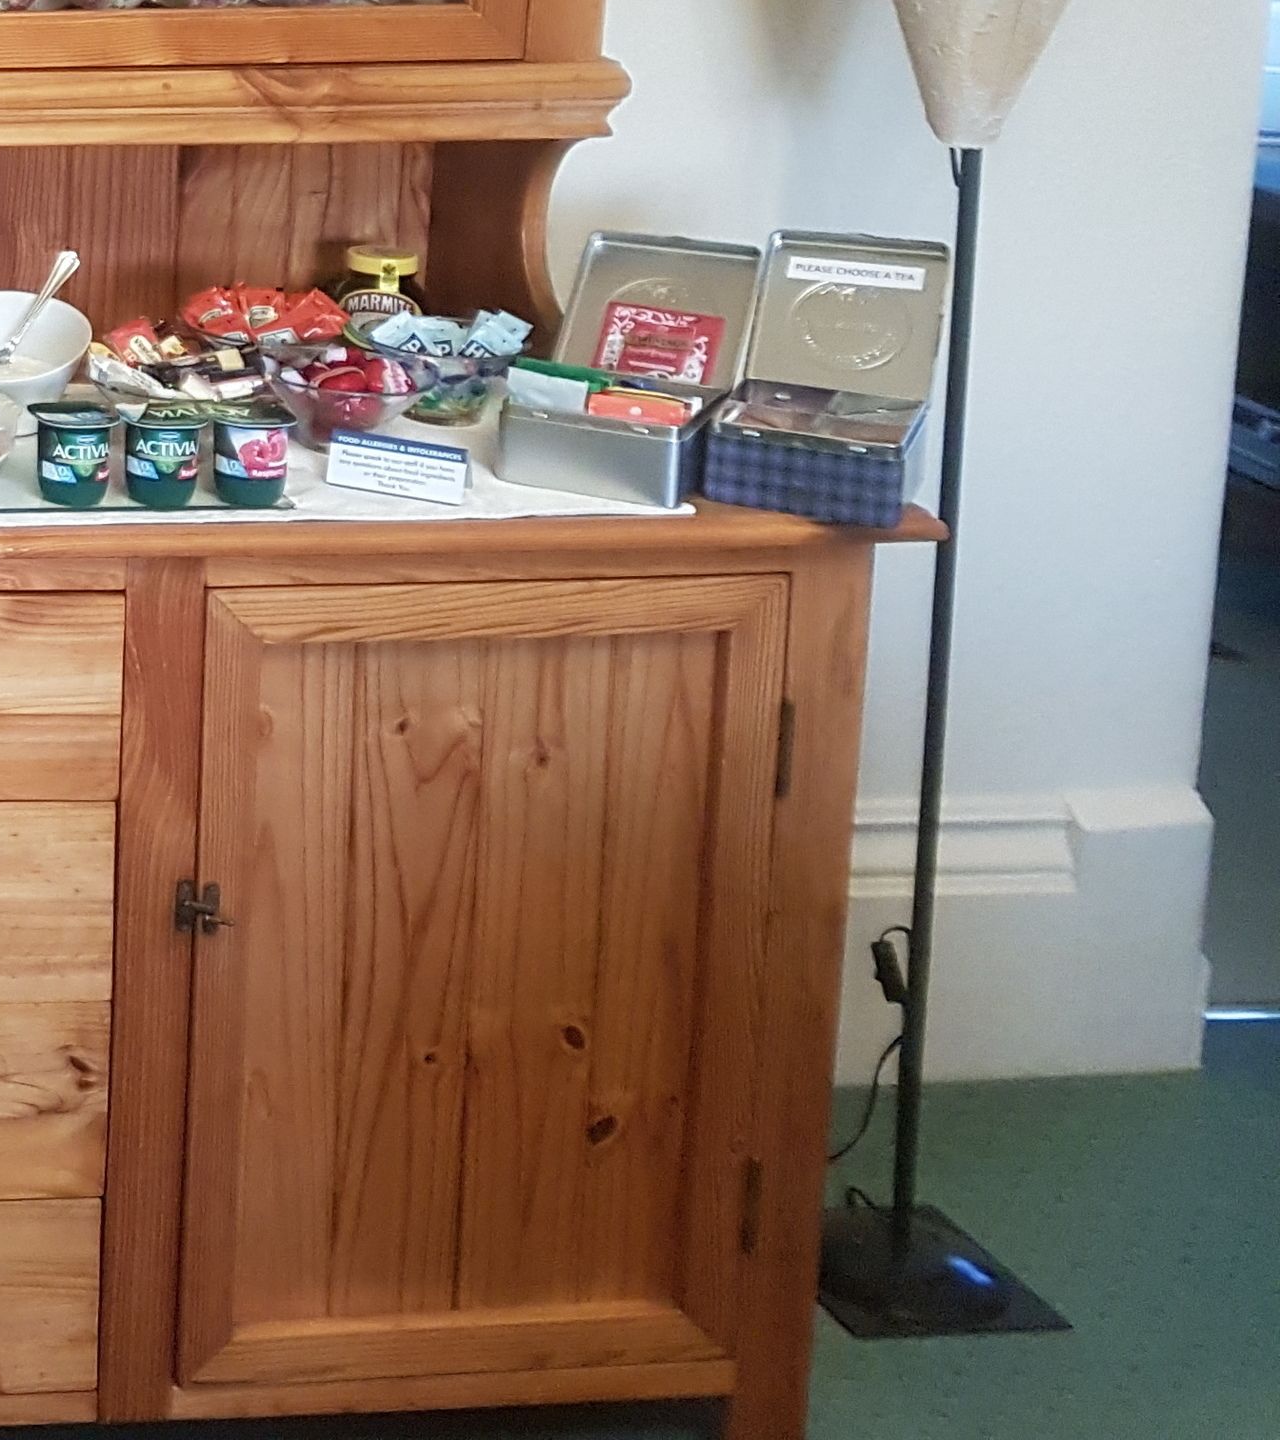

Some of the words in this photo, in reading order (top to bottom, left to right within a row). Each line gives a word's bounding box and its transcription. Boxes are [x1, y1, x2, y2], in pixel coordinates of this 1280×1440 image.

[796, 263, 833, 274] PLEASE
[836, 267, 881, 278] CHOOSE
[884, 271, 892, 279] A
[896, 272, 915, 280] TEA
[135, 439, 198, 457] ACTIVIA
[338, 435, 360, 445] FOOD
[52, 442, 109, 461] ACTIVIA
